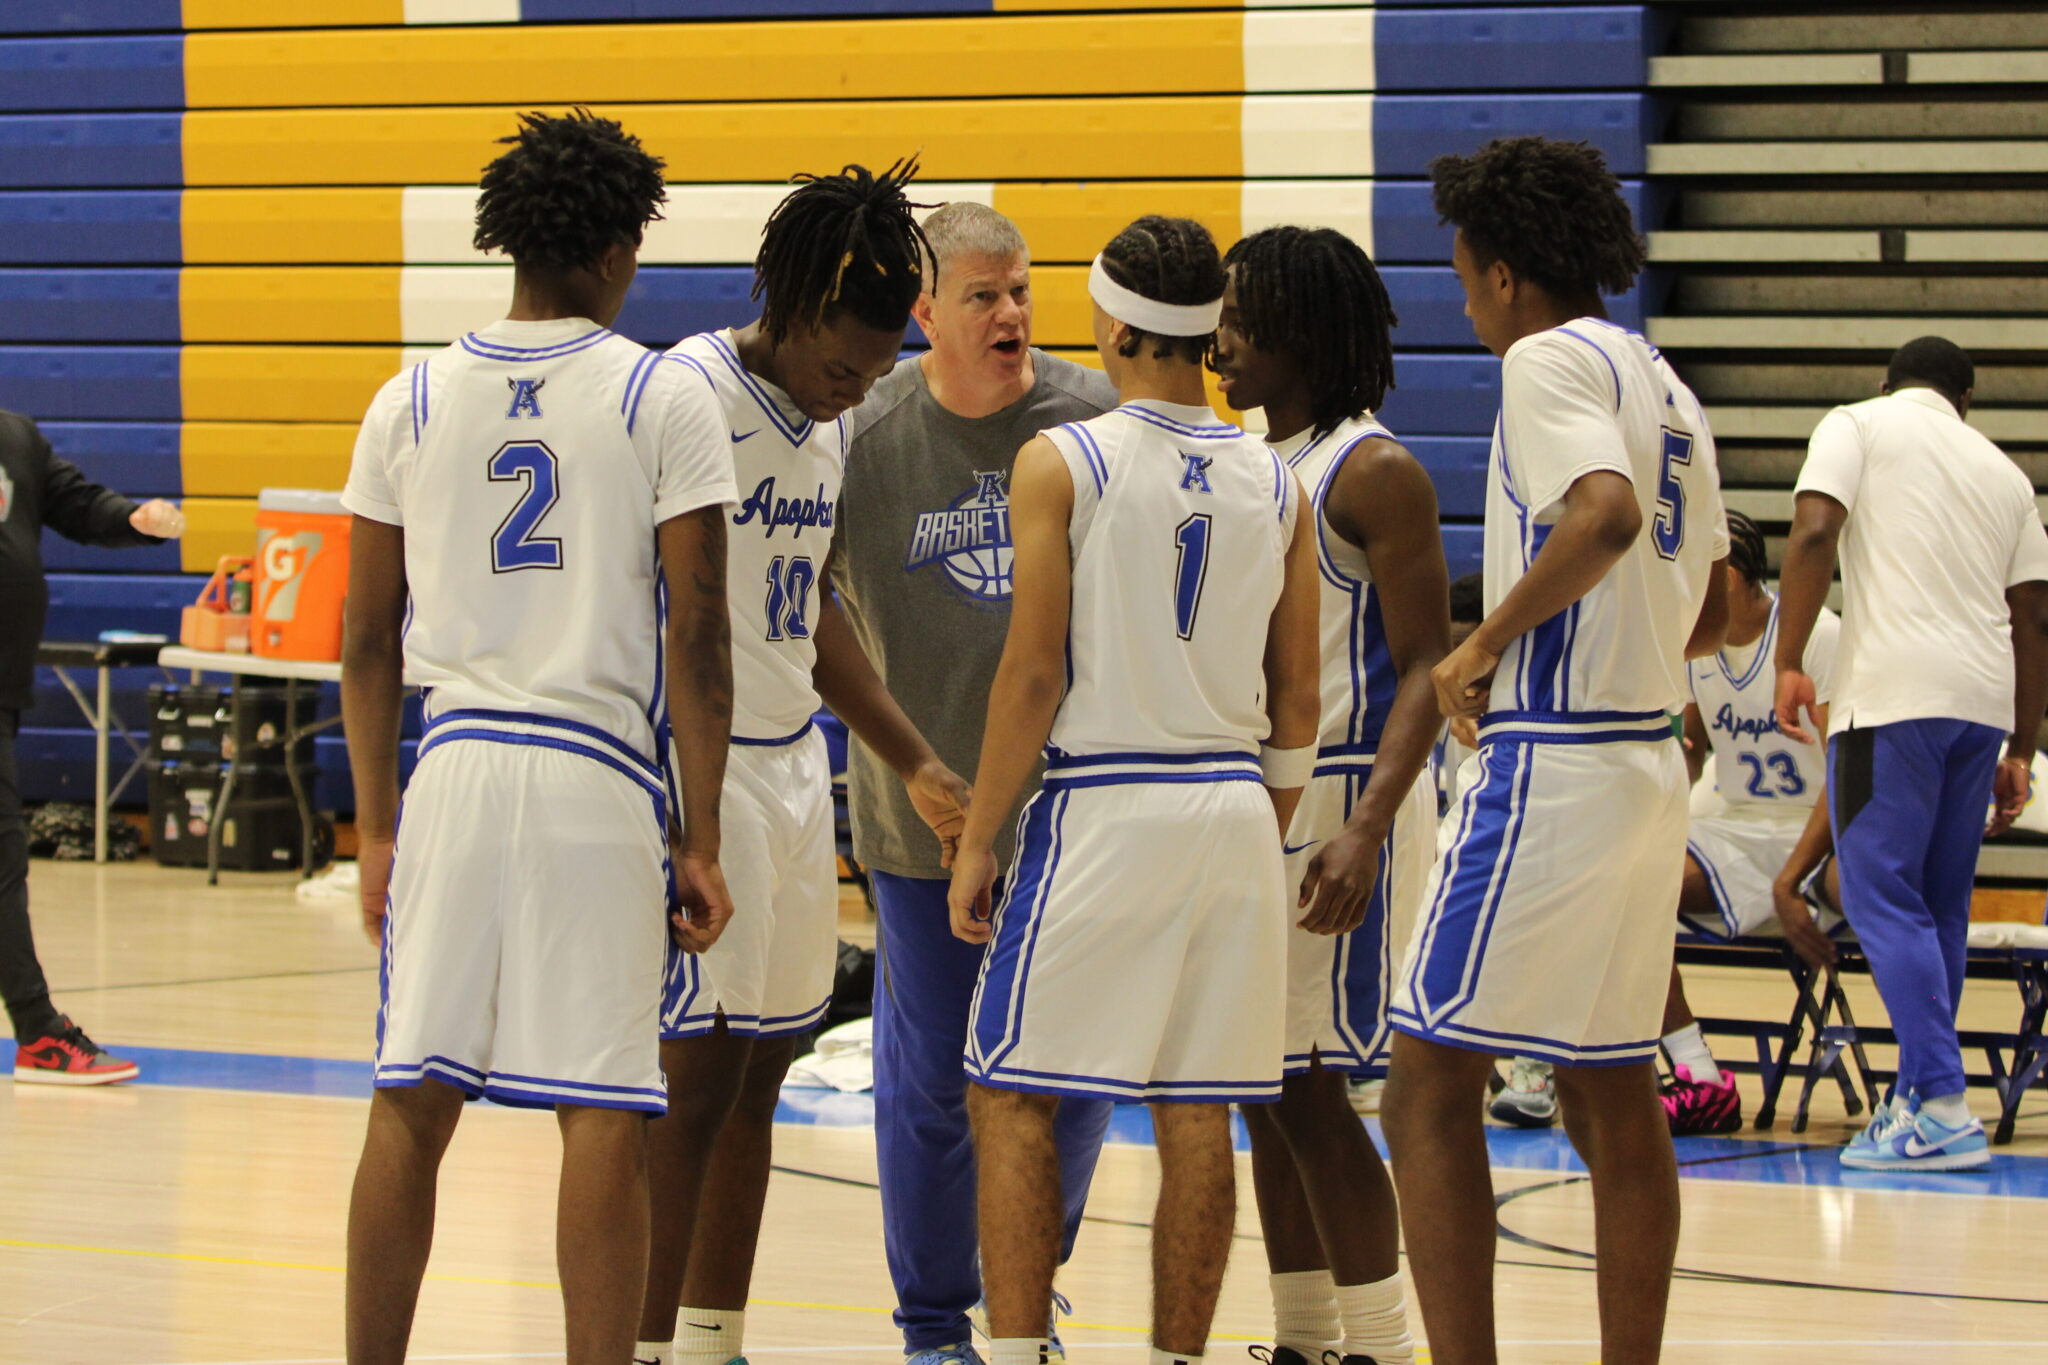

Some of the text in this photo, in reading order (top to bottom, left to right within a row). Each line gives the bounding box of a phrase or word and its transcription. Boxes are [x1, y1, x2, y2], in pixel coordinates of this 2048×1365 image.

[487, 439, 563, 574] 2
[732, 477, 834, 539] Apopka
[1651, 424, 1693, 562] 5
[265, 538, 296, 580] G
[907, 507, 1008, 566] BASKET
[765, 556, 815, 641] 10
[1174, 512, 1212, 641] 1
[1712, 702, 1783, 743] Apopk
[1737, 750, 1807, 799] 23
